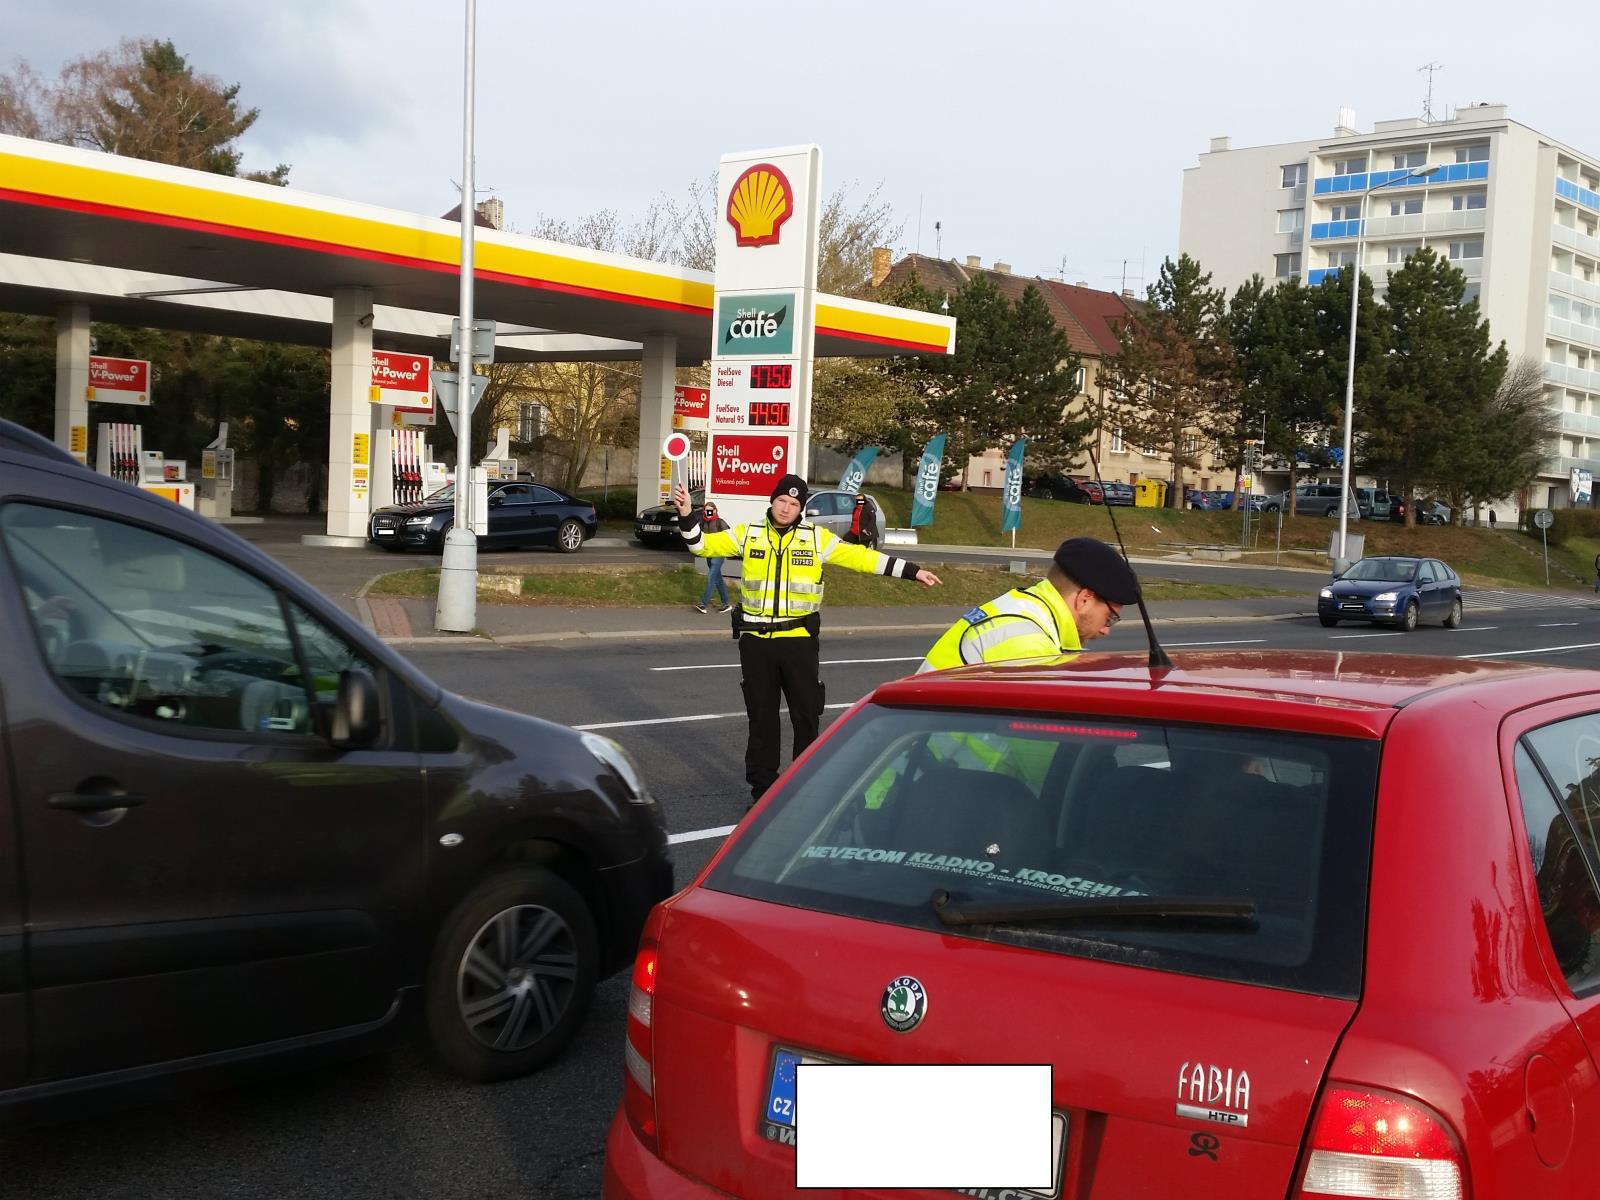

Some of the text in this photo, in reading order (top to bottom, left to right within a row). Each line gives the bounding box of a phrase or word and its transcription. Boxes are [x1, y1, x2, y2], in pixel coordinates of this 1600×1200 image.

[737, 307, 756, 318] Shell
[730, 310, 778, 338] café
[90, 361, 108, 370] Shell
[371, 357, 389, 366] Shell
[90, 369, 135, 382] V-Power
[372, 366, 417, 380] V-Power
[717, 367, 742, 376] FuelSave
[717, 378, 734, 387] Diesel
[715, 404, 740, 413] FuelSave
[715, 415, 745, 424] Natural 95
[716, 444, 740, 457] Shell
[716, 457, 778, 475] V-Power
[922, 463, 939, 501] café
[801, 846, 905, 864] NEVECOM
[908, 852, 996, 873] KLADNO
[1178, 1061, 1250, 1110] FABIA
[773, 1097, 792, 1116] CZ
[1208, 1110, 1238, 1123] HTP
